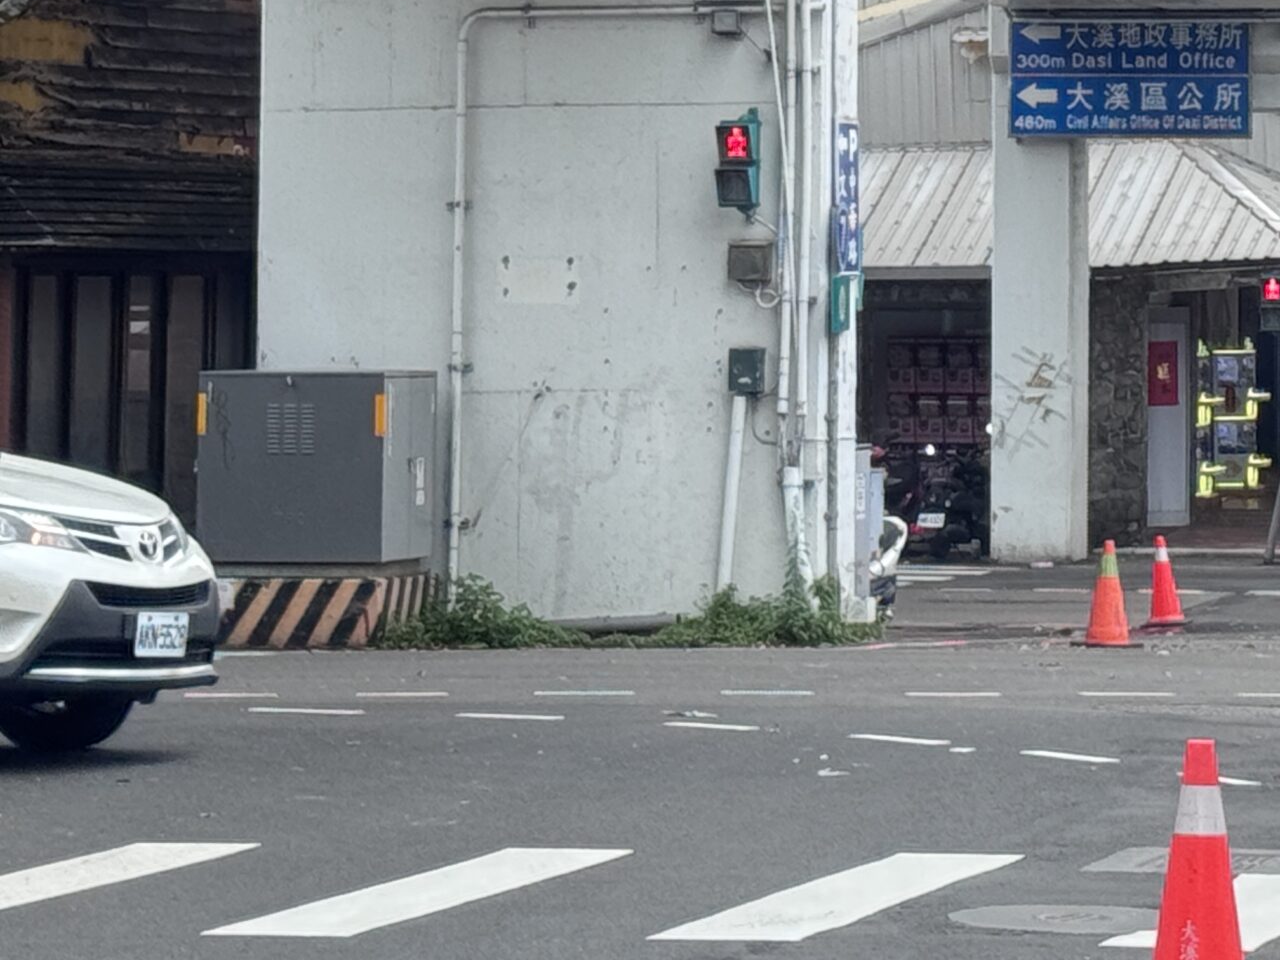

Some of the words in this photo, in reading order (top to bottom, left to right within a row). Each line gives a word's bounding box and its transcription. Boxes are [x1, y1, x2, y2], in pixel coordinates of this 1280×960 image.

[1065, 22, 1244, 50] 大溪地政事務所
[1016, 53, 1066, 69] 300m
[1121, 52, 1168, 69] Land
[1179, 52, 1236, 69] Office
[1066, 81, 1243, 112] 大溪區公所
[1091, 114, 1127, 130] Affairs
